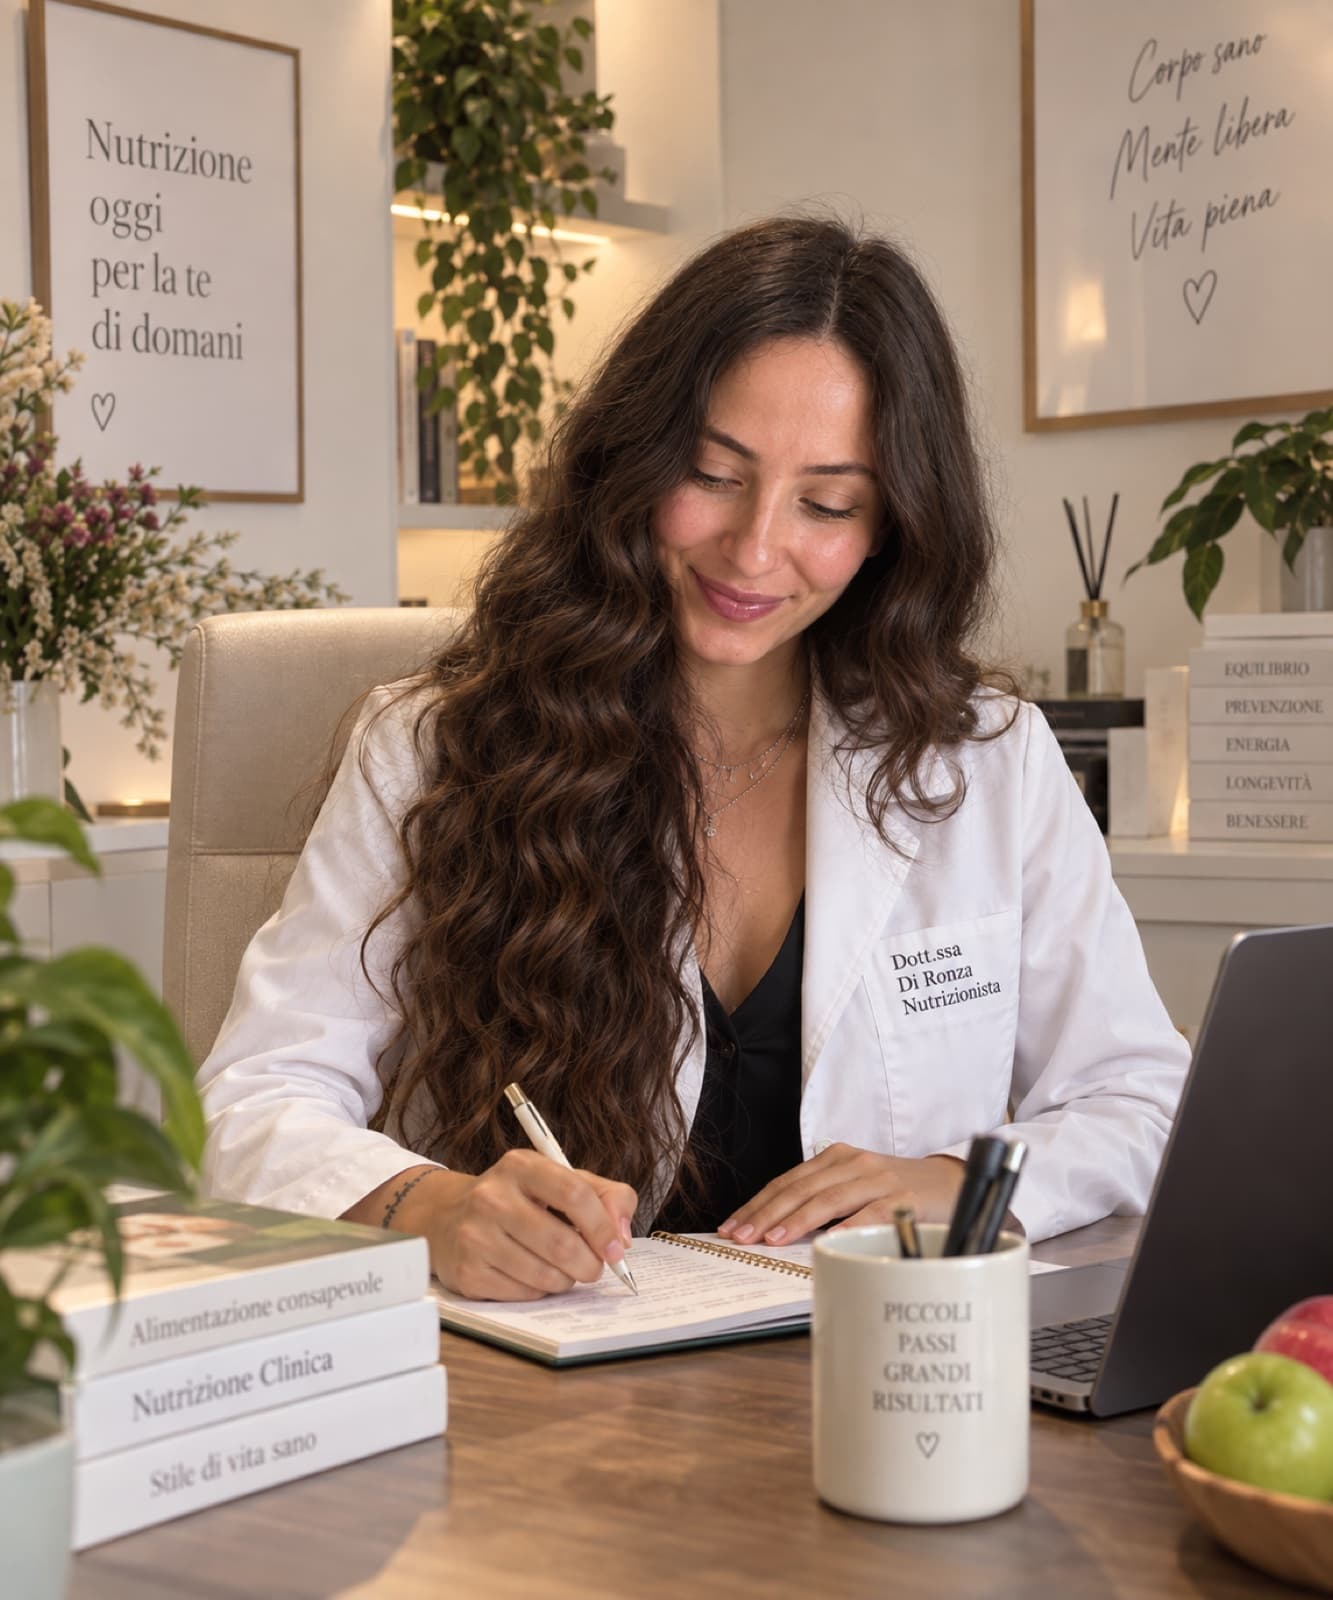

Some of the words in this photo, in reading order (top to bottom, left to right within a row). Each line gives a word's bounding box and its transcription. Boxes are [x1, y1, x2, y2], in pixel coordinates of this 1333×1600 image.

[1128, 38, 1206, 103] Corpo
[1211, 33, 1267, 74] sano
[86, 118, 252, 184] Nutrizione
[1110, 116, 1203, 200] Mente
[1213, 96, 1296, 157] libera
[90, 193, 163, 241] oggi
[1132, 199, 1192, 261] Vita
[1201, 187, 1281, 253] piena
[91, 257, 145, 298] per
[152, 252, 177, 295] la
[186, 264, 212, 298] te
[92, 308, 122, 351] di
[132, 312, 243, 360] domani
[1225, 662, 1310, 678] EQUILIBRIO
[1225, 699, 1324, 715] PREVENZIONE
[1226, 738, 1291, 753] ENERGIA
[1226, 773, 1313, 791] LONGEVITÀ
[1226, 814, 1308, 830] BENESSERE
[890, 944, 963, 971] Dott.ssa
[896, 974, 920, 993] Di
[922, 965, 973, 987] Ronza
[902, 981, 1001, 1016] Nutrizionista
[129, 1296, 272, 1348] Alimentazione
[276, 1271, 383, 1315] consapevole
[883, 1302, 972, 1323] PICCOLI
[899, 1333, 957, 1353] PASSI
[132, 1371, 252, 1423] Nutrizione
[259, 1351, 334, 1387] Clinica
[883, 1362, 971, 1383] GRANDI
[872, 1392, 984, 1412] RISULTATI
[149, 1465, 196, 1497] Stile
[201, 1452, 222, 1481] di
[227, 1445, 266, 1476] vita
[271, 1431, 318, 1462] sano
